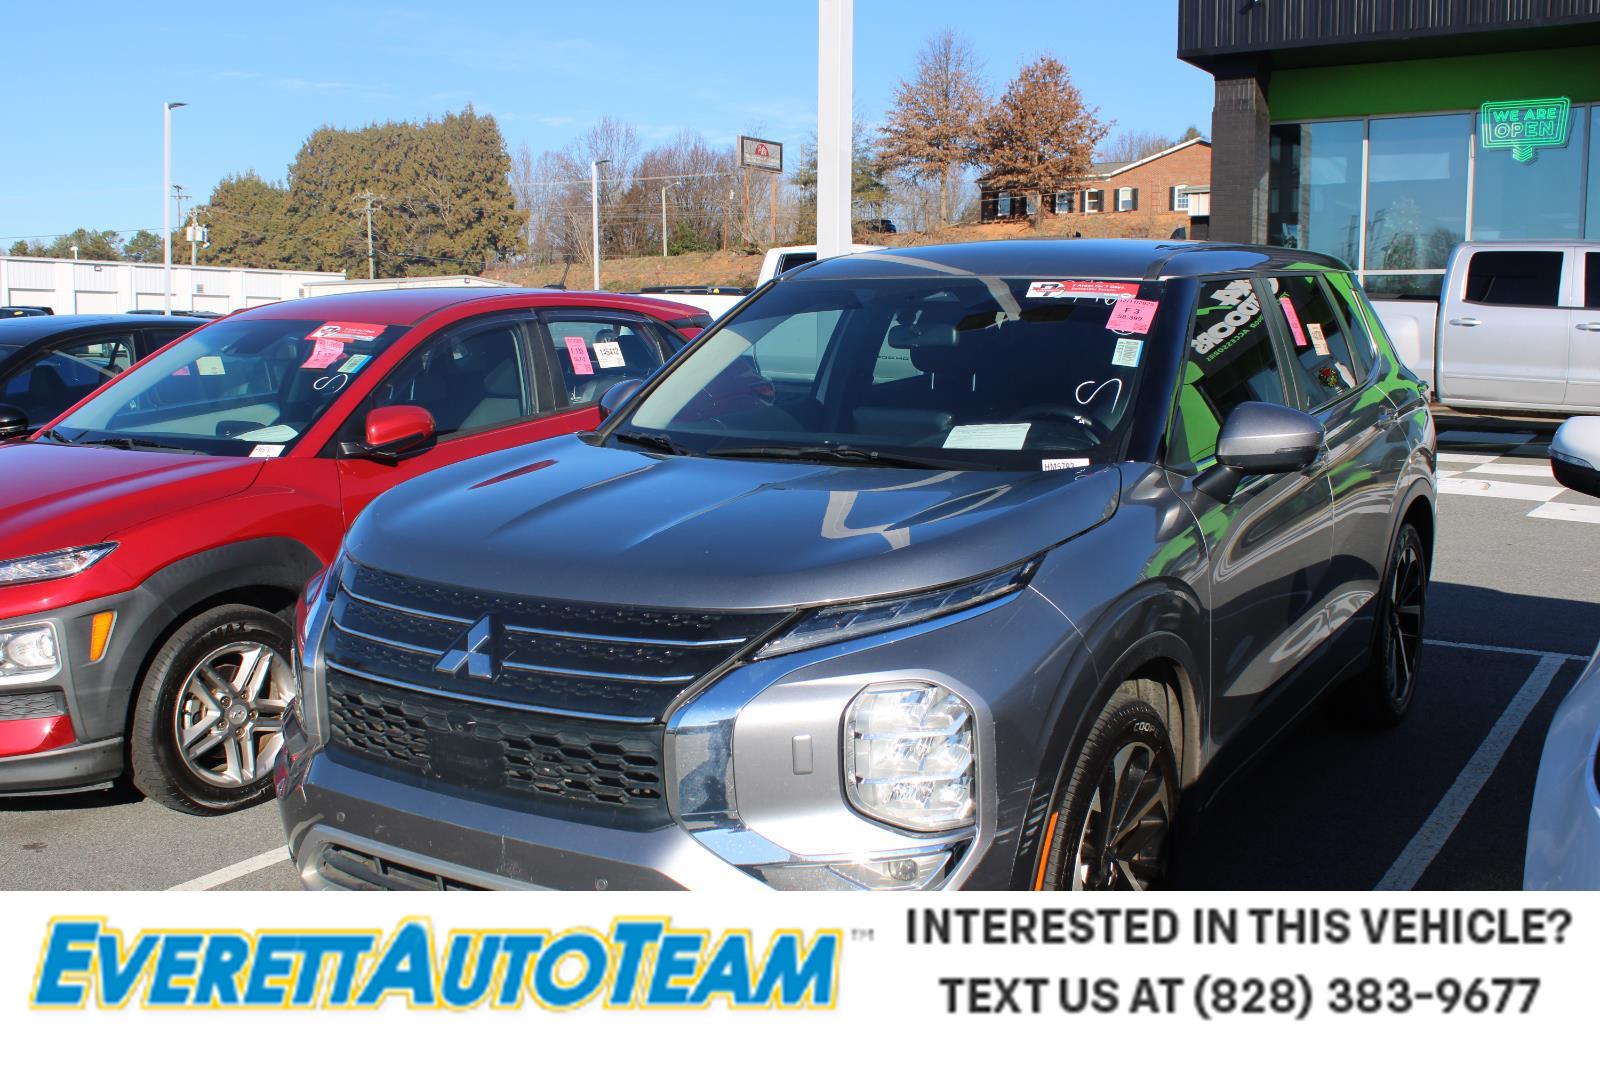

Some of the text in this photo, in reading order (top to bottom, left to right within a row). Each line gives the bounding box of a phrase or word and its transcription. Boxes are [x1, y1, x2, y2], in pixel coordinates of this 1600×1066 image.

[1493, 107, 1557, 122] WE ARE
[1494, 120, 1554, 138] OPEN
